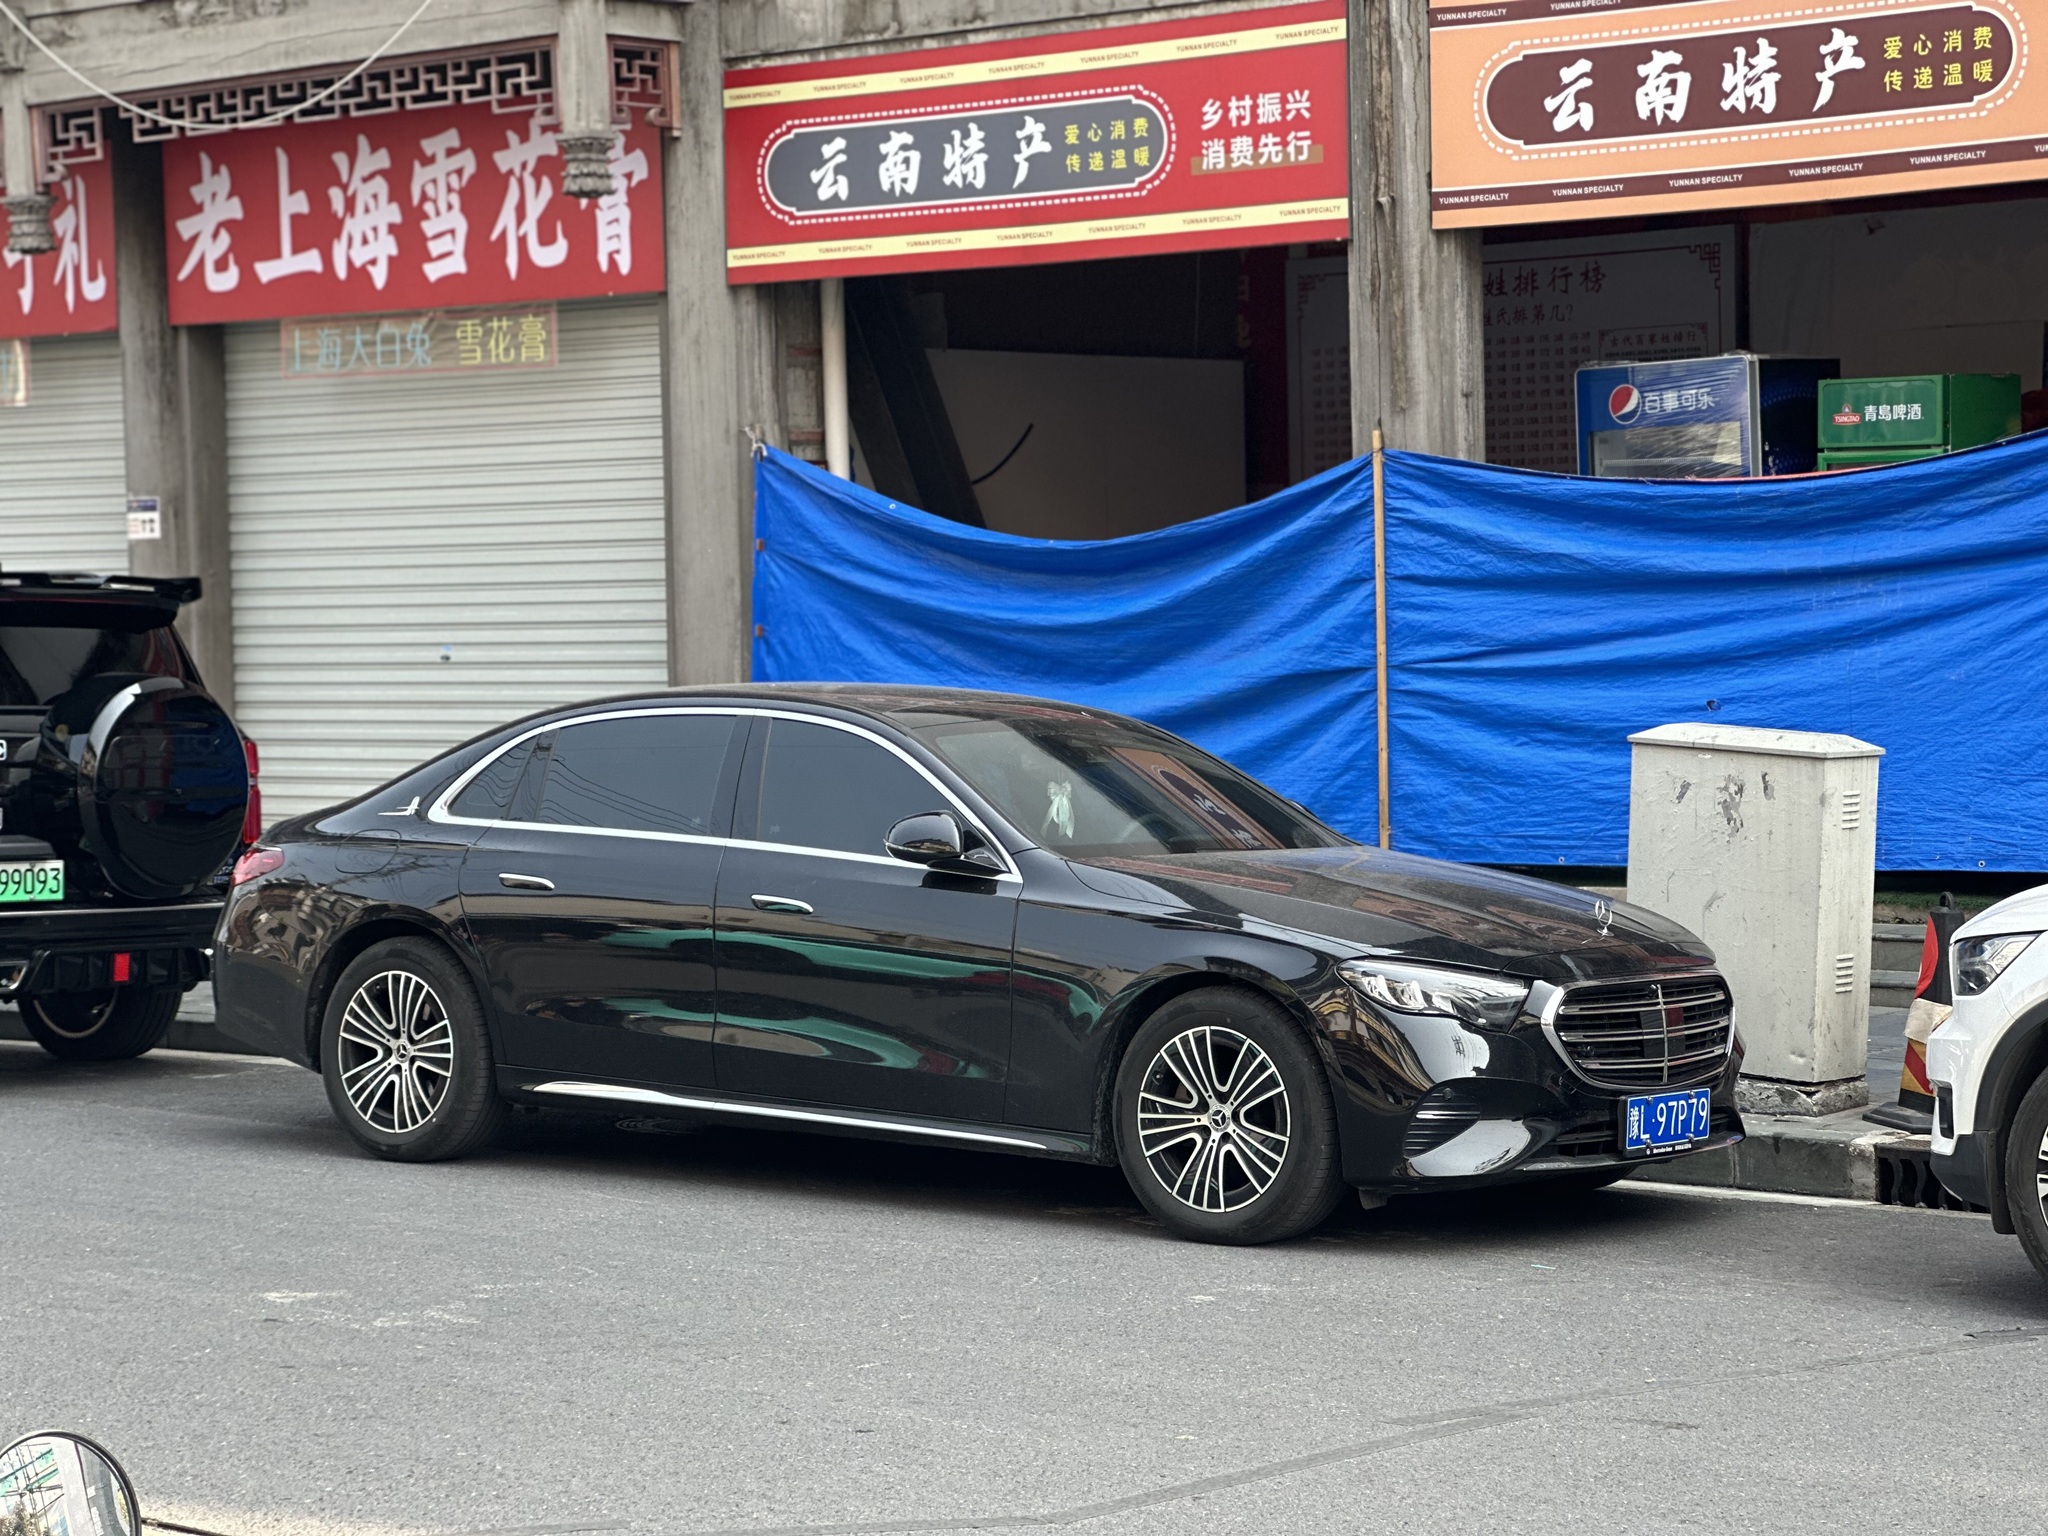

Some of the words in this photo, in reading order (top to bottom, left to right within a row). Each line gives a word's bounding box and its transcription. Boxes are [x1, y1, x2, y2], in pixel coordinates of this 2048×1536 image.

[1551, 0, 1580, 11] YUNNAN
[1437, 11, 1466, 21] YUNNAN
[1468, 7, 1506, 19] SPECIALTY
[1276, 30, 1302, 40] YUNNAN
[1304, 25, 1338, 37] SPECIALTY
[1177, 43, 1202, 53] YUNNAN
[1203, 38, 1237, 50] SPECIALTY
[1883, 26, 1993, 60] 爱心消费
[1080, 55, 1105, 64] YUNNAN
[1106, 50, 1139, 61] SPECIALTY
[989, 65, 1012, 74] YUNNAN
[1013, 61, 1044, 72] SPECIALTY
[900, 75, 923, 84] YUNNAN
[924, 71, 954, 82] SPECIALTY
[1543, 27, 1865, 133] 云南特产
[1883, 59, 1993, 93] 传递温暖
[813, 84, 836, 93] YUNNAN
[837, 81, 866, 91] SPECIALTY
[729, 93, 751, 102] YUNNAN
[752, 90, 780, 99] SPECIALTY
[1200, 89, 1311, 131] 乡村振兴
[1064, 117, 1148, 146] 爱心消费
[810, 115, 1052, 201] 云南特产
[1201, 131, 1312, 171] 消费先行
[1910, 154, 1942, 165] YUNNAN
[1943, 149, 1986, 162] SPECIALTY
[1065, 146, 1150, 173] 传递温暖
[1789, 166, 1821, 177] YUNNAN
[1822, 162, 1863, 174] SPECIALTY
[1669, 177, 1700, 188] YUNNAN
[1701, 173, 1742, 185] SPECIALTY
[1553, 187, 1582, 197] YUNNAN
[1584, 183, 1623, 195] SPECIALTY
[176, 118, 649, 292] 老上海雪花膏
[1439, 195, 1469, 205] YUNNAN
[1470, 192, 1509, 203] SPECIALTY
[1280, 208, 1305, 217] YUNNAN
[1307, 205, 1341, 215] SPECIALTY
[1182, 216, 1208, 226] YUNNAN
[1209, 213, 1242, 224] SPECIALTY
[1088, 225, 1113, 234] YUNNAN
[1114, 222, 1145, 232] SPECIALTY
[906, 239, 930, 248] YUNNAN
[931, 237, 962, 246] SPECIALTY
[997, 233, 1021, 241] YUNNAN
[1021, 230, 1053, 240] SPECIALTY
[733, 253, 755, 261] YUNNAN
[755, 250, 785, 259] SPECIALTY
[818, 246, 841, 254] YUNNAN
[842, 243, 872, 253] SPECIALTY
[292, 321, 432, 372] 上海大白兔
[456, 313, 547, 366] 雪花膏
[1643, 387, 1716, 414] 百事可乐
[1834, 415, 1861, 424] TSINGTAO
[0, 868, 60, 896] 99093
